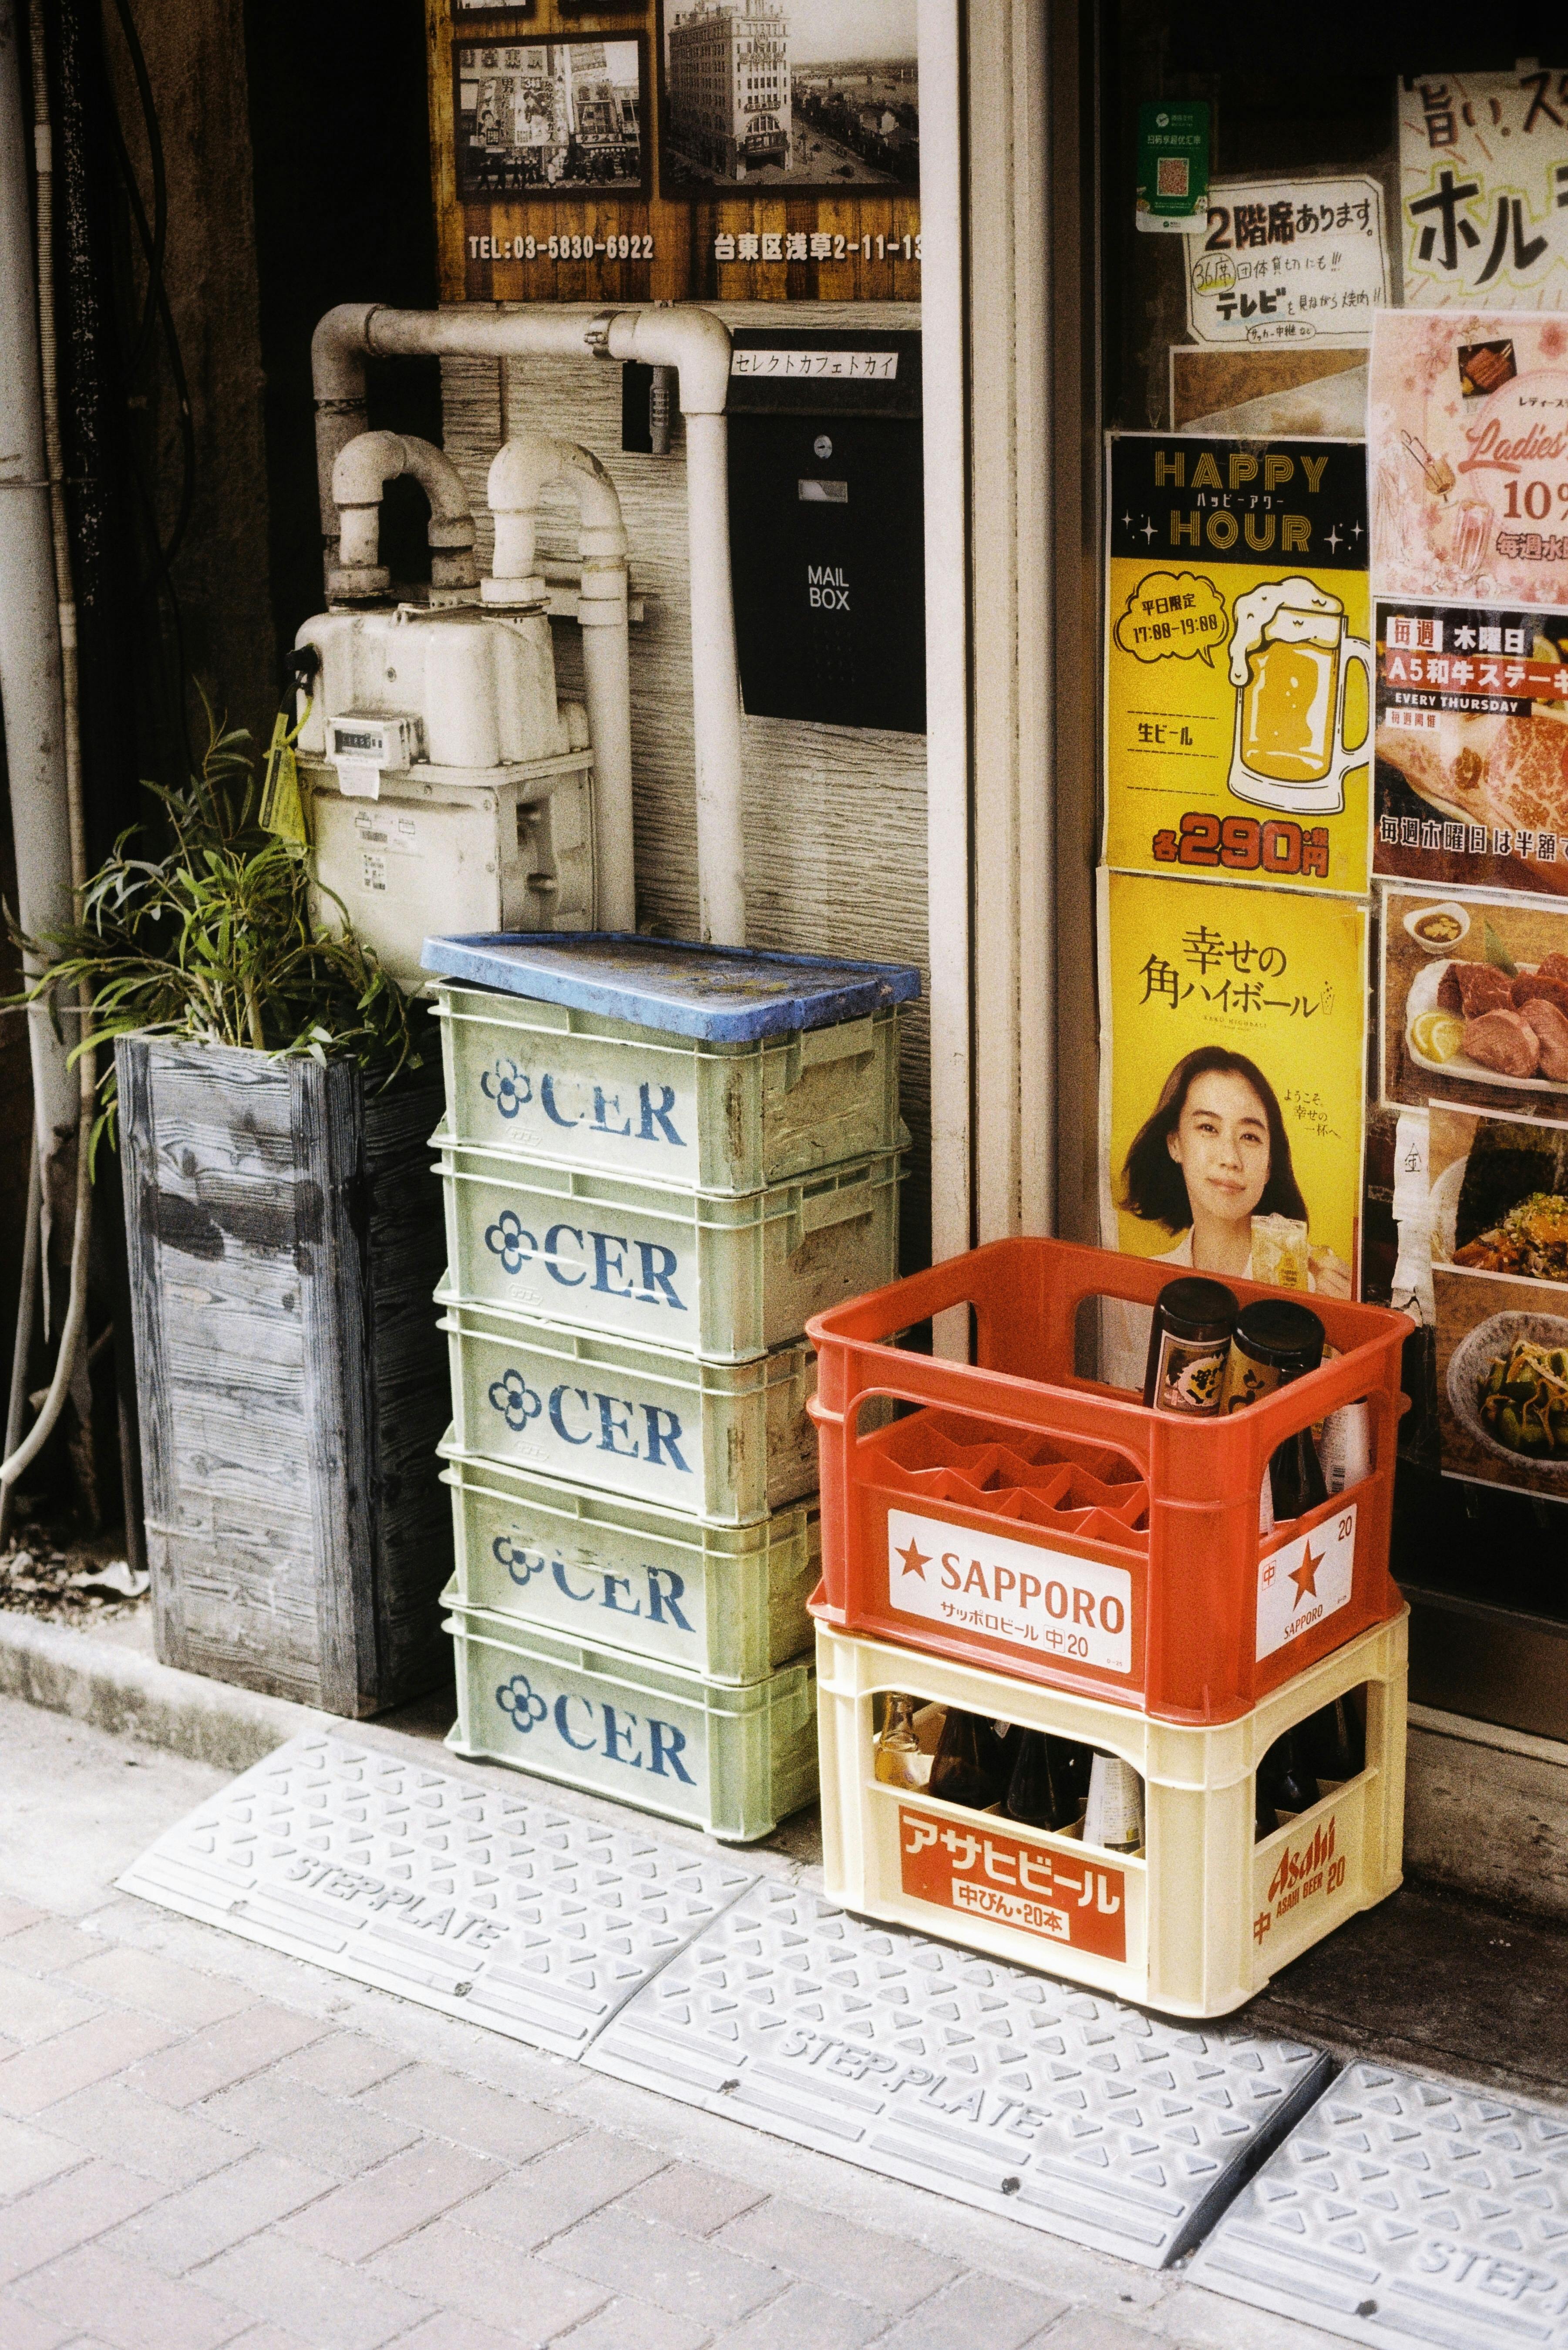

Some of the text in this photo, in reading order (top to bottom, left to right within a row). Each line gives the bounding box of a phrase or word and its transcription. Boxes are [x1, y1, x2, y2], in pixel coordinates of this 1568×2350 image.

[1205, 198, 1373, 251] 2階席あります。
[1410, 171, 1568, 286] ホル
[468, 234, 653, 259] TEL:03-5830-6922
[736, 354, 895, 377] セレクトカフェトカイ
[1519, 396, 1568, 408] レディース
[1154, 451, 1329, 492] HAPPY
[1197, 492, 1284, 509] ハッピーアワー
[1171, 510, 1312, 552] HOUR
[1496, 531, 1568, 561] 毎週水
[808, 565, 850, 587] MAIL
[809, 587, 850, 610] BOX
[1141, 593, 1197, 616] 平日限定
[1133, 614, 1218, 644] 17:00-19:00
[1394, 619, 1525, 653] 毎週 木曜日
[1388, 656, 1568, 694] A5和牛ステーキ
[1395, 692, 1519, 713] EVERY THURSDAY
[1137, 722, 1193, 746] 生ビール
[1391, 711, 1436, 728] 毎週開催
[1181, 925, 1287, 977] 幸せの
[1138, 953, 1320, 1018] 角ハイボール
[540, 1072, 687, 1147] CER
[1284, 1089, 1324, 1107] ようこそ。
[1294, 1105, 1328, 1122] 幸せの
[1303, 1123, 1342, 1139] 一杯へ。
[544, 1223, 688, 1311] CER
[548, 1384, 694, 1474] CER
[1338, 1515, 1353, 1542] 20
[551, 1548, 697, 1633] CER
[1263, 1565, 1275, 1586] 中
[941, 1552, 1124, 1635] SAPPORO
[940, 1601, 1039, 1641] サッポロビール
[1284, 1604, 1323, 1640] SAPPORO
[554, 1693, 698, 1787] CER
[902, 1815, 1120, 1915] アサヒビール
[1277, 1855, 1346, 1918] ASAHI BEER 20
[1253, 1912, 1271, 1945] 中
